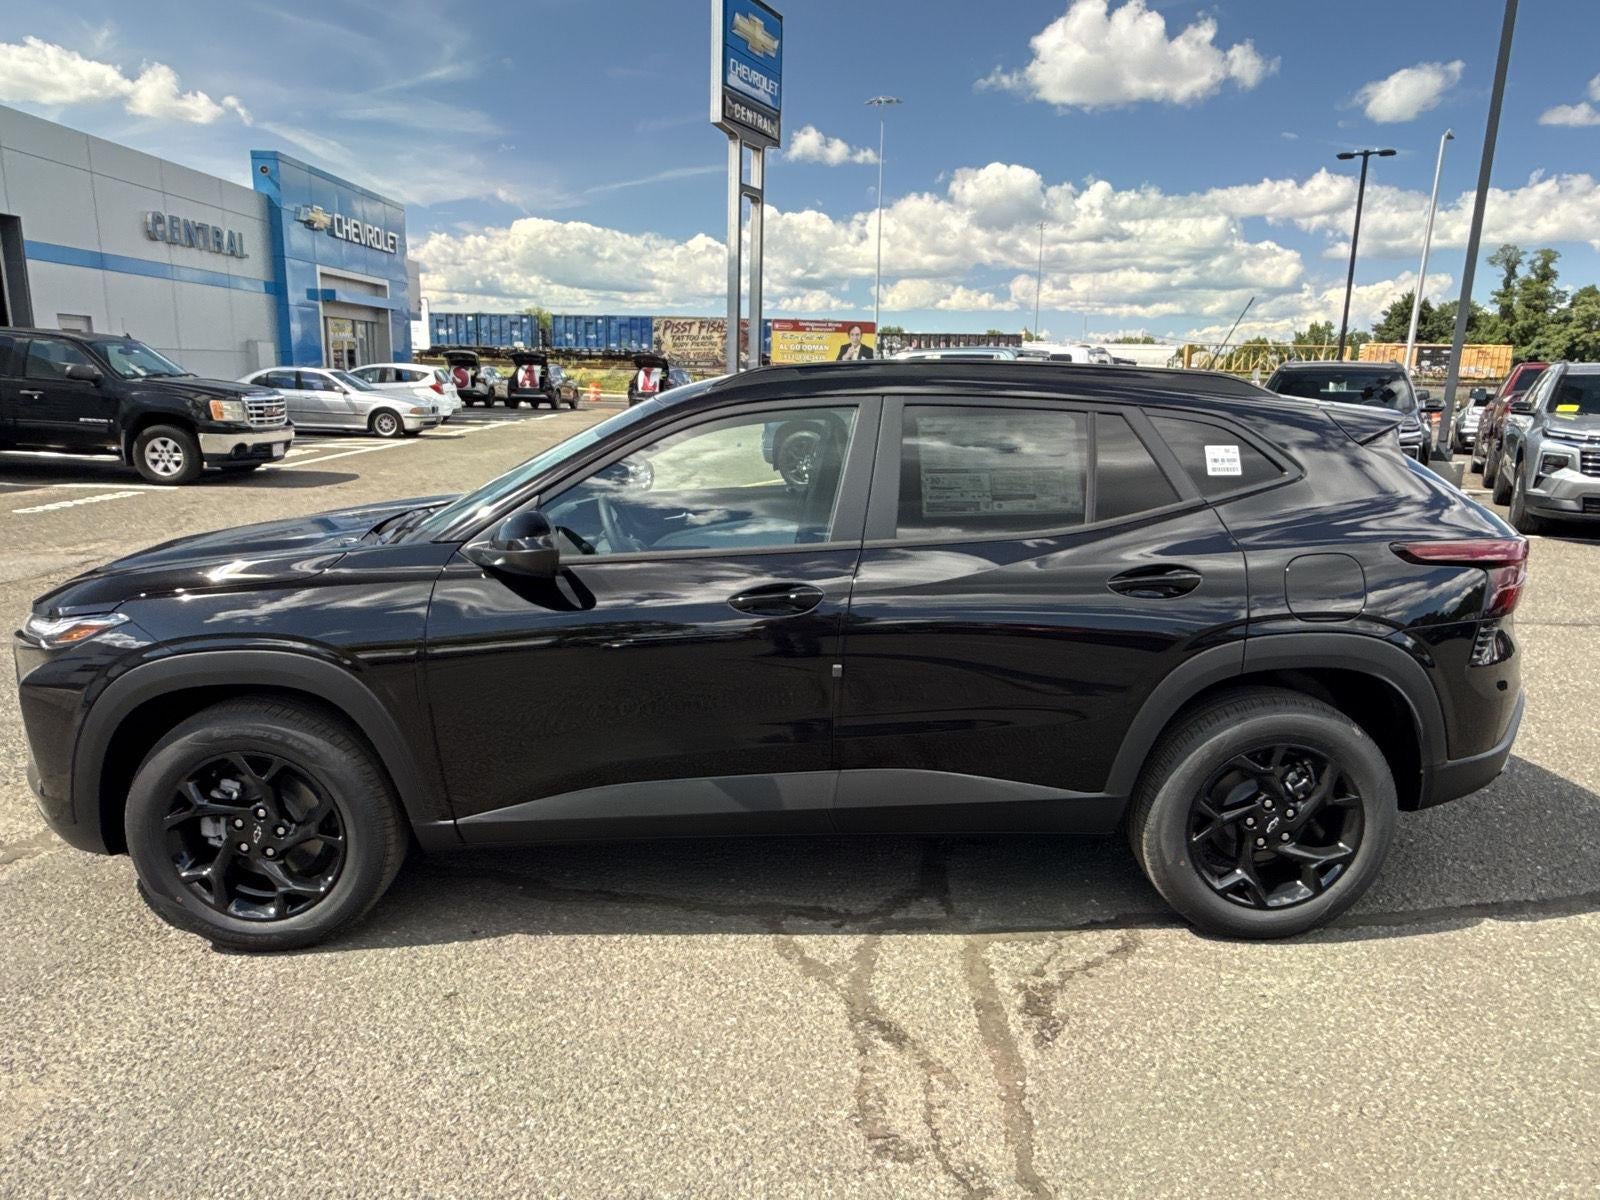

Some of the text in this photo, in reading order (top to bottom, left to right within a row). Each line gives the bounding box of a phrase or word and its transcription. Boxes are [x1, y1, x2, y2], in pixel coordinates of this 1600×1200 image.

[730, 58, 779, 96] CHEVROLET
[734, 103, 772, 133] CENTRAL
[145, 211, 248, 258] CENTRAL
[334, 213, 399, 254] CHEVROLET
[663, 319, 725, 335] PISST FISH
[519, 365, 539, 388] A
